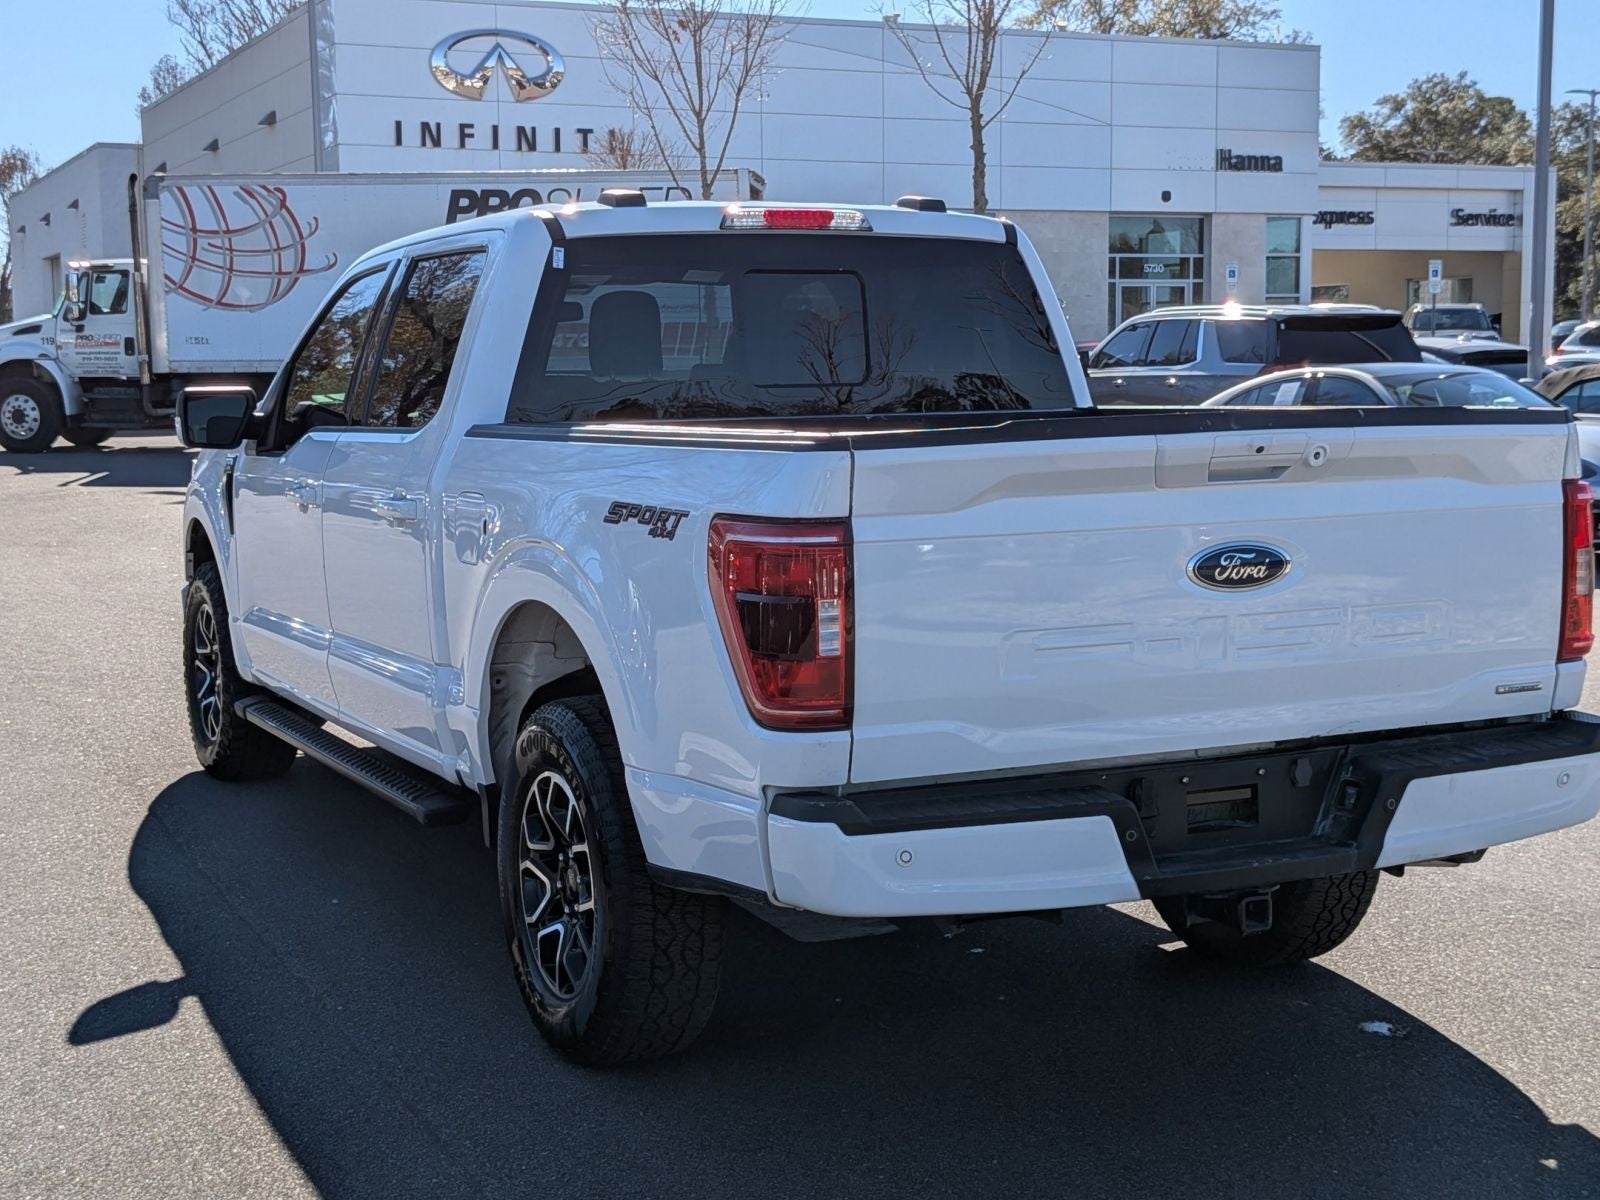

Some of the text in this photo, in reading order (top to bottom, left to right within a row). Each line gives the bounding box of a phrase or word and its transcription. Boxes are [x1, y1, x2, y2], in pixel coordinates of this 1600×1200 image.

[1217, 149, 1283, 172] Hanna
[1452, 208, 1515, 227] Service
[1143, 263, 1165, 273] 5730
[41, 336, 55, 346] 119
[603, 501, 691, 529] SPORT
[1214, 552, 1270, 581] Ford
